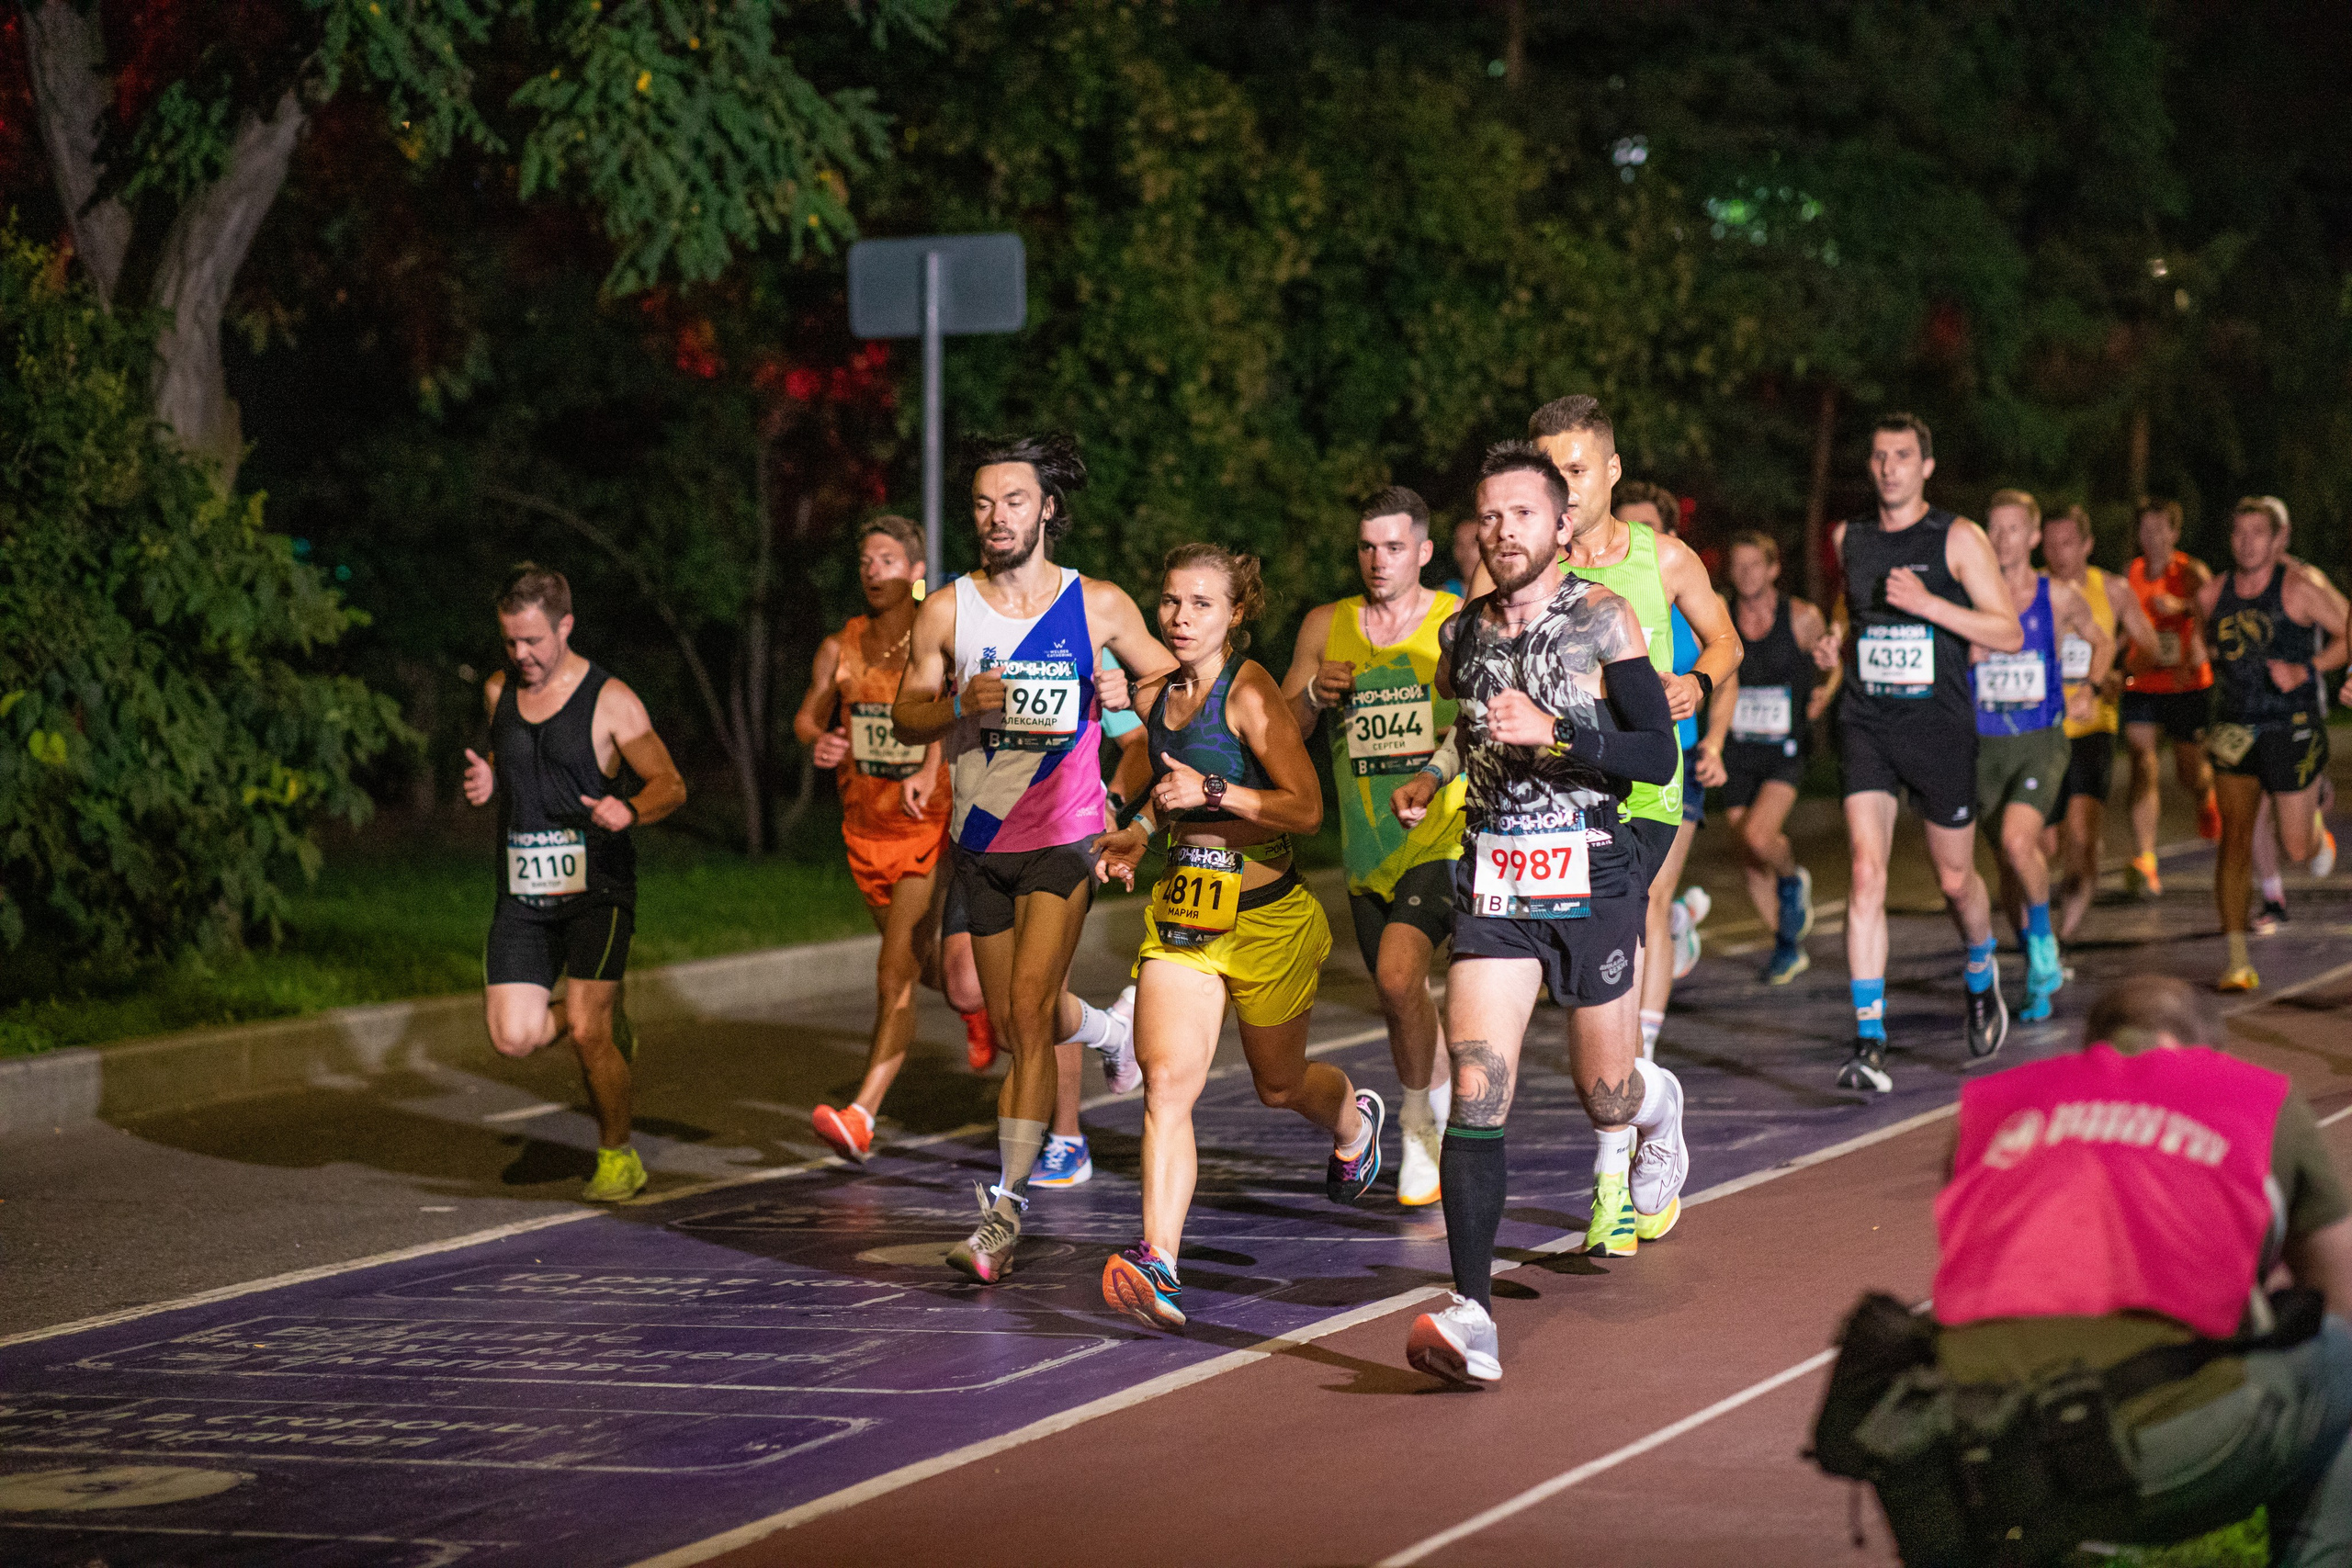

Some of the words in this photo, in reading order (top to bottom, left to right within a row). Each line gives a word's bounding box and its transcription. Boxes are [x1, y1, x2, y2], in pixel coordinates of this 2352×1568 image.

[1868, 648, 1922, 669] 4332
[1001, 687, 1068, 715] 967
[1001, 717, 1057, 727] АЛЕКСАНДР
[1355, 711, 1423, 741] 3044
[1498, 809, 1573, 831] ОЧНОЙ
[516, 853, 575, 879] 2110
[1491, 848, 1572, 881] 9987
[1162, 874, 1223, 909] 4811
[1168, 908, 1199, 919] МАРИЯ
[502, 1273, 582, 1282] 10
[580, 1276, 710, 1285] раз
[452, 1284, 748, 1297] сторону
[390, 1358, 673, 1372] вправо
